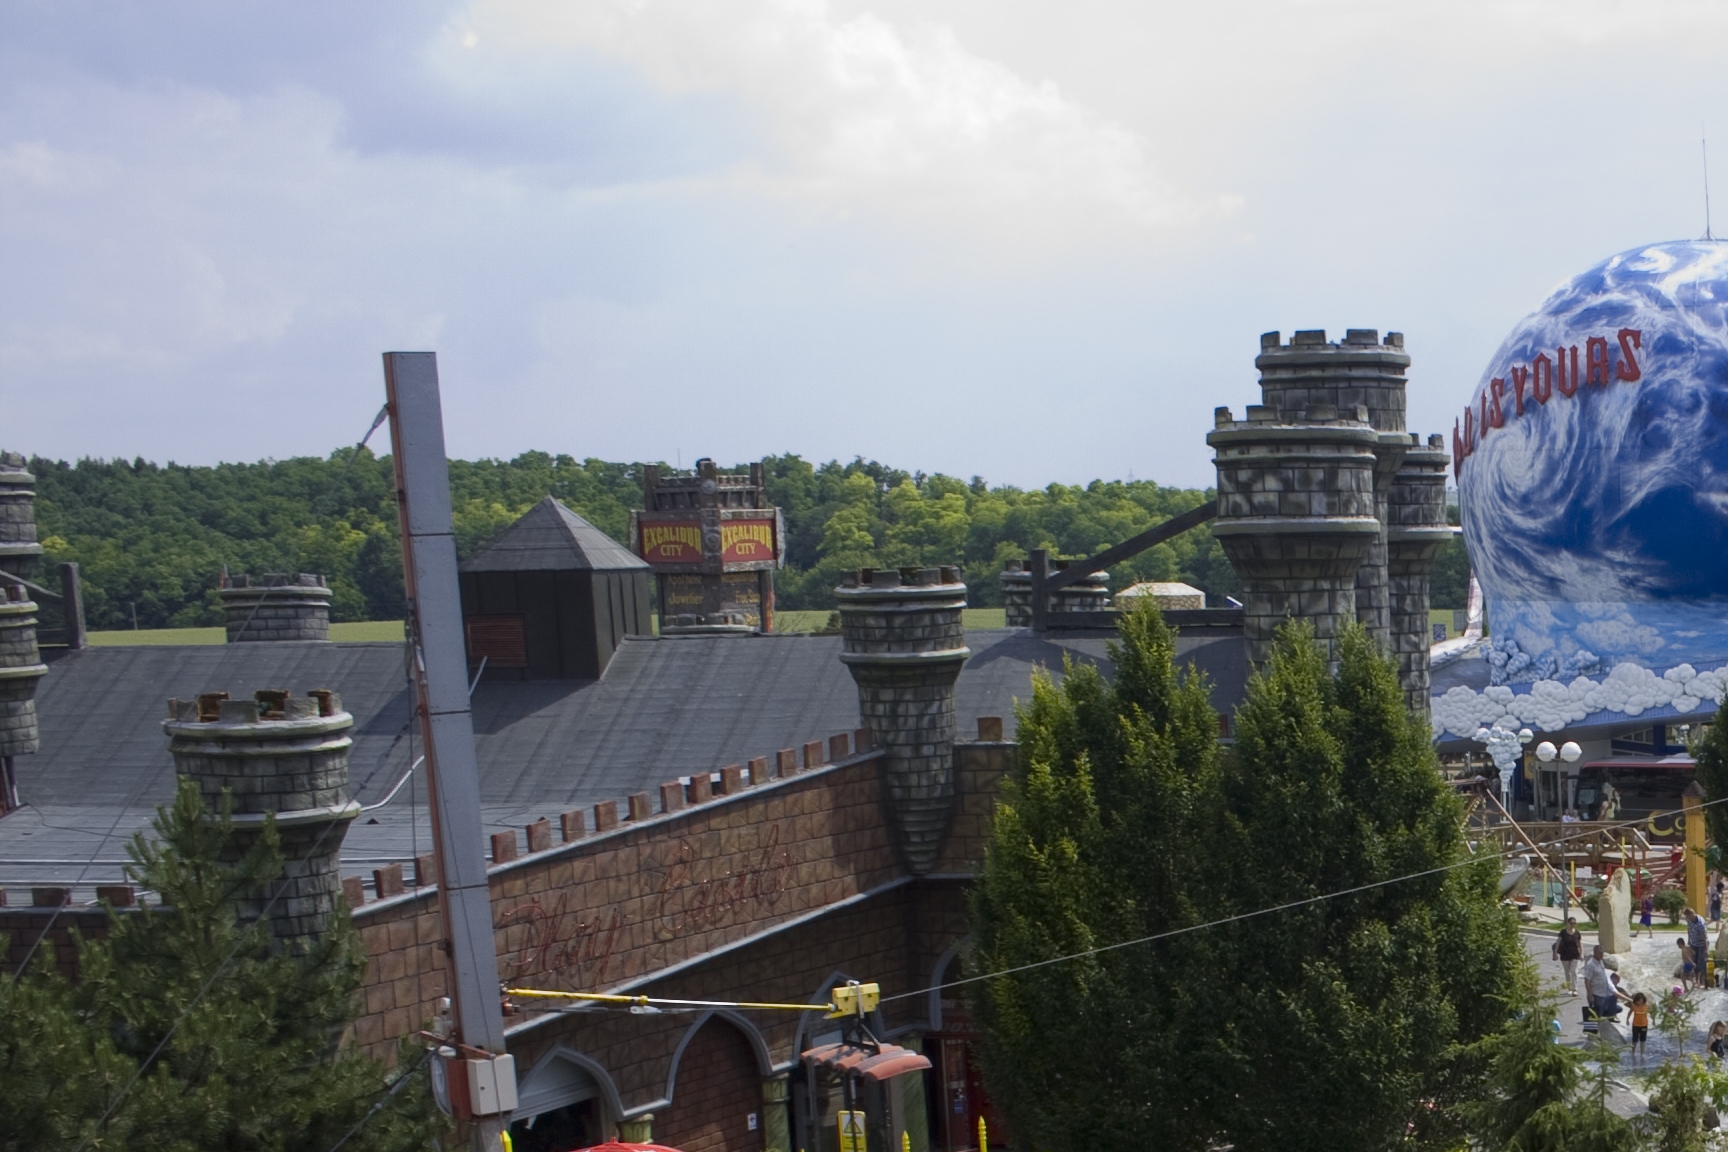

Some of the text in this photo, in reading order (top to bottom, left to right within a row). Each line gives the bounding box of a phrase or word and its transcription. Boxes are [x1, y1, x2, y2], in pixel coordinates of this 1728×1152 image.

[1479, 327, 1642, 440] IS YOURS
[643, 526, 702, 555] EXCALIBUR
[661, 544, 682, 555] CITY
[721, 524, 773, 555] EXCALIBUR
[735, 542, 756, 555] CITY
